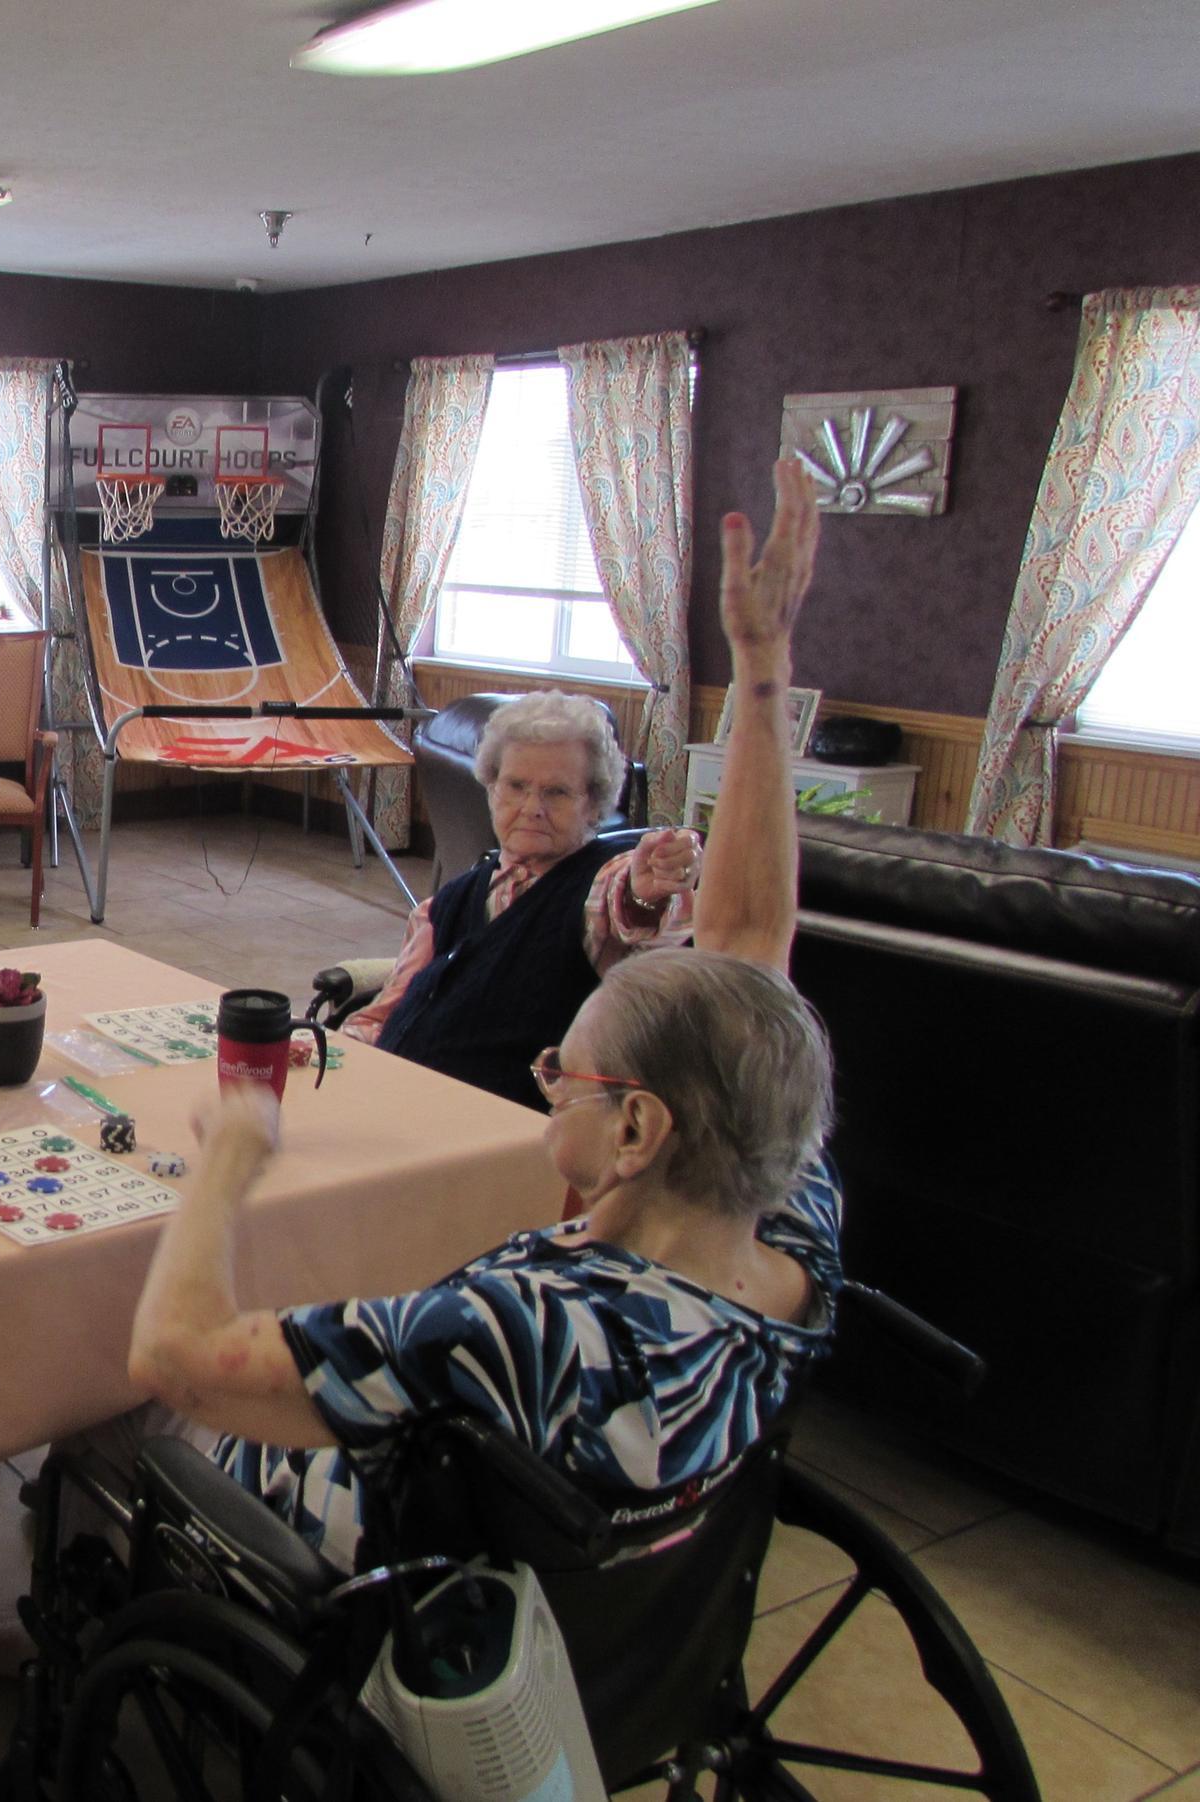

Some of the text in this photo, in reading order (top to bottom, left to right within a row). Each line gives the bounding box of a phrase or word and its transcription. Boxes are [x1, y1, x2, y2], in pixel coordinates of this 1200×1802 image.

[172, 415, 195, 429] EA
[71, 447, 296, 470] FULLCOURT HOOPS
[1, 1135, 18, 1145] G
[32, 1129, 47, 1138] O
[17, 1147, 41, 1159] 56
[9, 1167, 33, 1179] 34
[74, 1153, 96, 1164] 70
[3, 1188, 26, 1200] 21
[64, 1174, 88, 1186] 53
[27, 1202, 47, 1214] 17
[59, 1196, 81, 1208] 41
[87, 1188, 110, 1200] 57
[83, 1209, 108, 1223] 35
[115, 1201, 140, 1213] 48
[145, 1192, 173, 1204] 72
